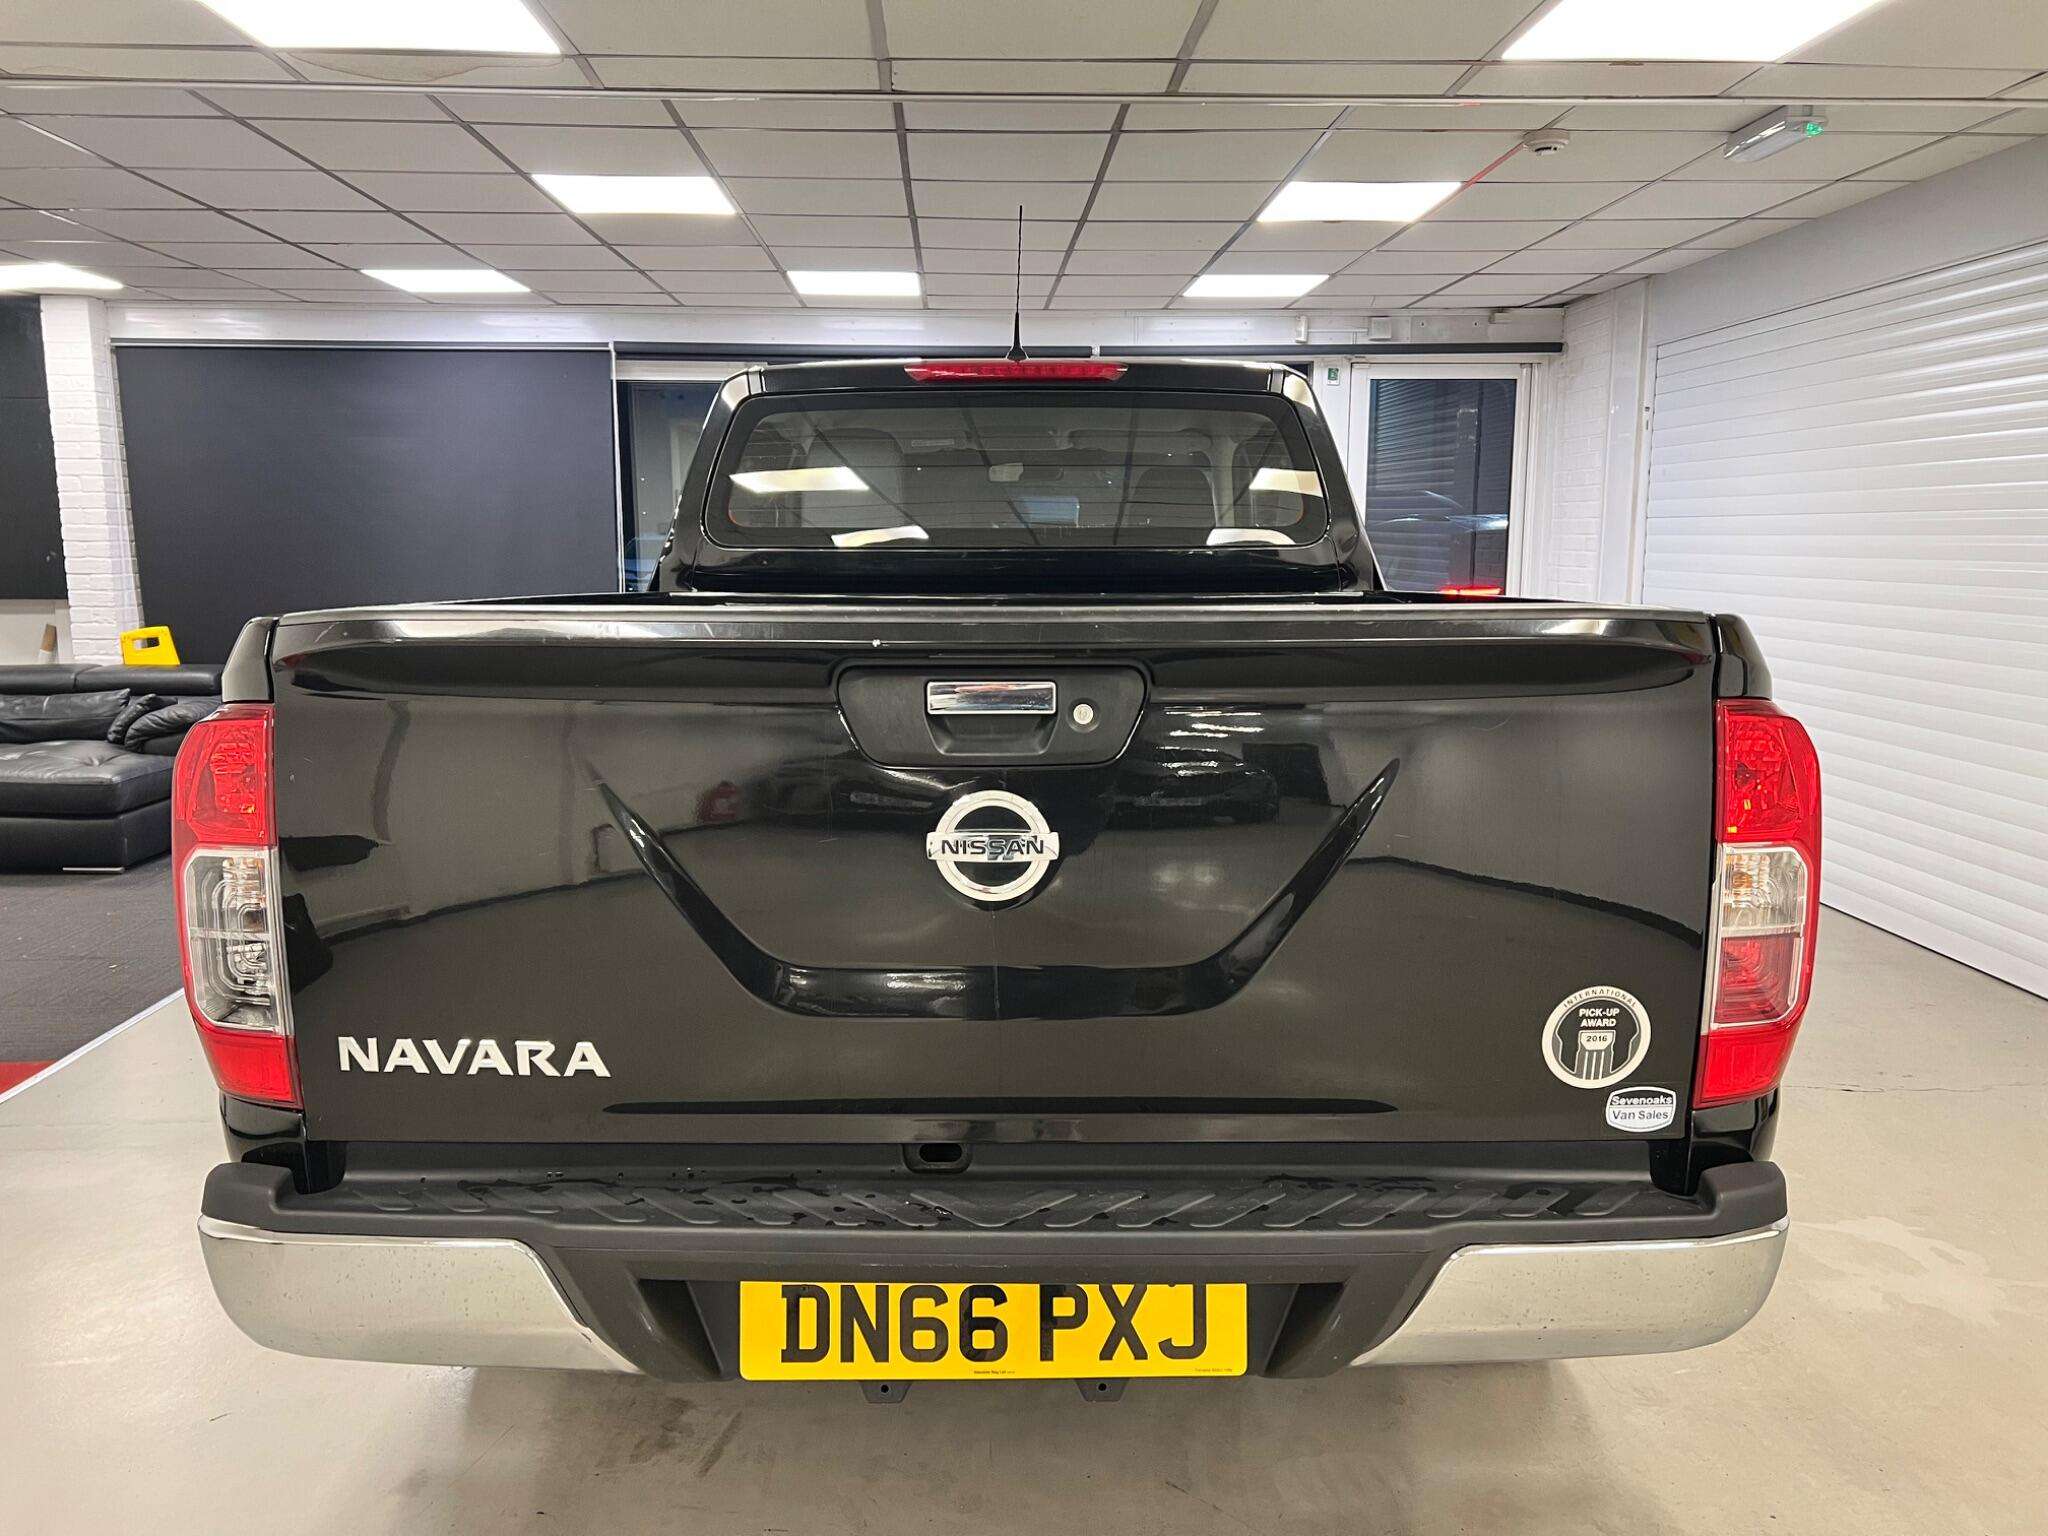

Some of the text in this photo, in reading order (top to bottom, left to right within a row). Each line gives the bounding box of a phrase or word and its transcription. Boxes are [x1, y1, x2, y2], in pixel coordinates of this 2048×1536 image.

[941, 839, 1044, 855] NISSAN
[1563, 988, 1637, 1008] INTERNATIONAL
[1579, 1008, 1620, 1018] PICK-UP
[1580, 1018, 1617, 1027] AWARD
[338, 1036, 612, 1078] NAVARA
[1611, 1095, 1673, 1106] Sevenoaks
[1612, 1110, 1669, 1120] Van Sales
[781, 1283, 1208, 1363] DN66 PXJ
